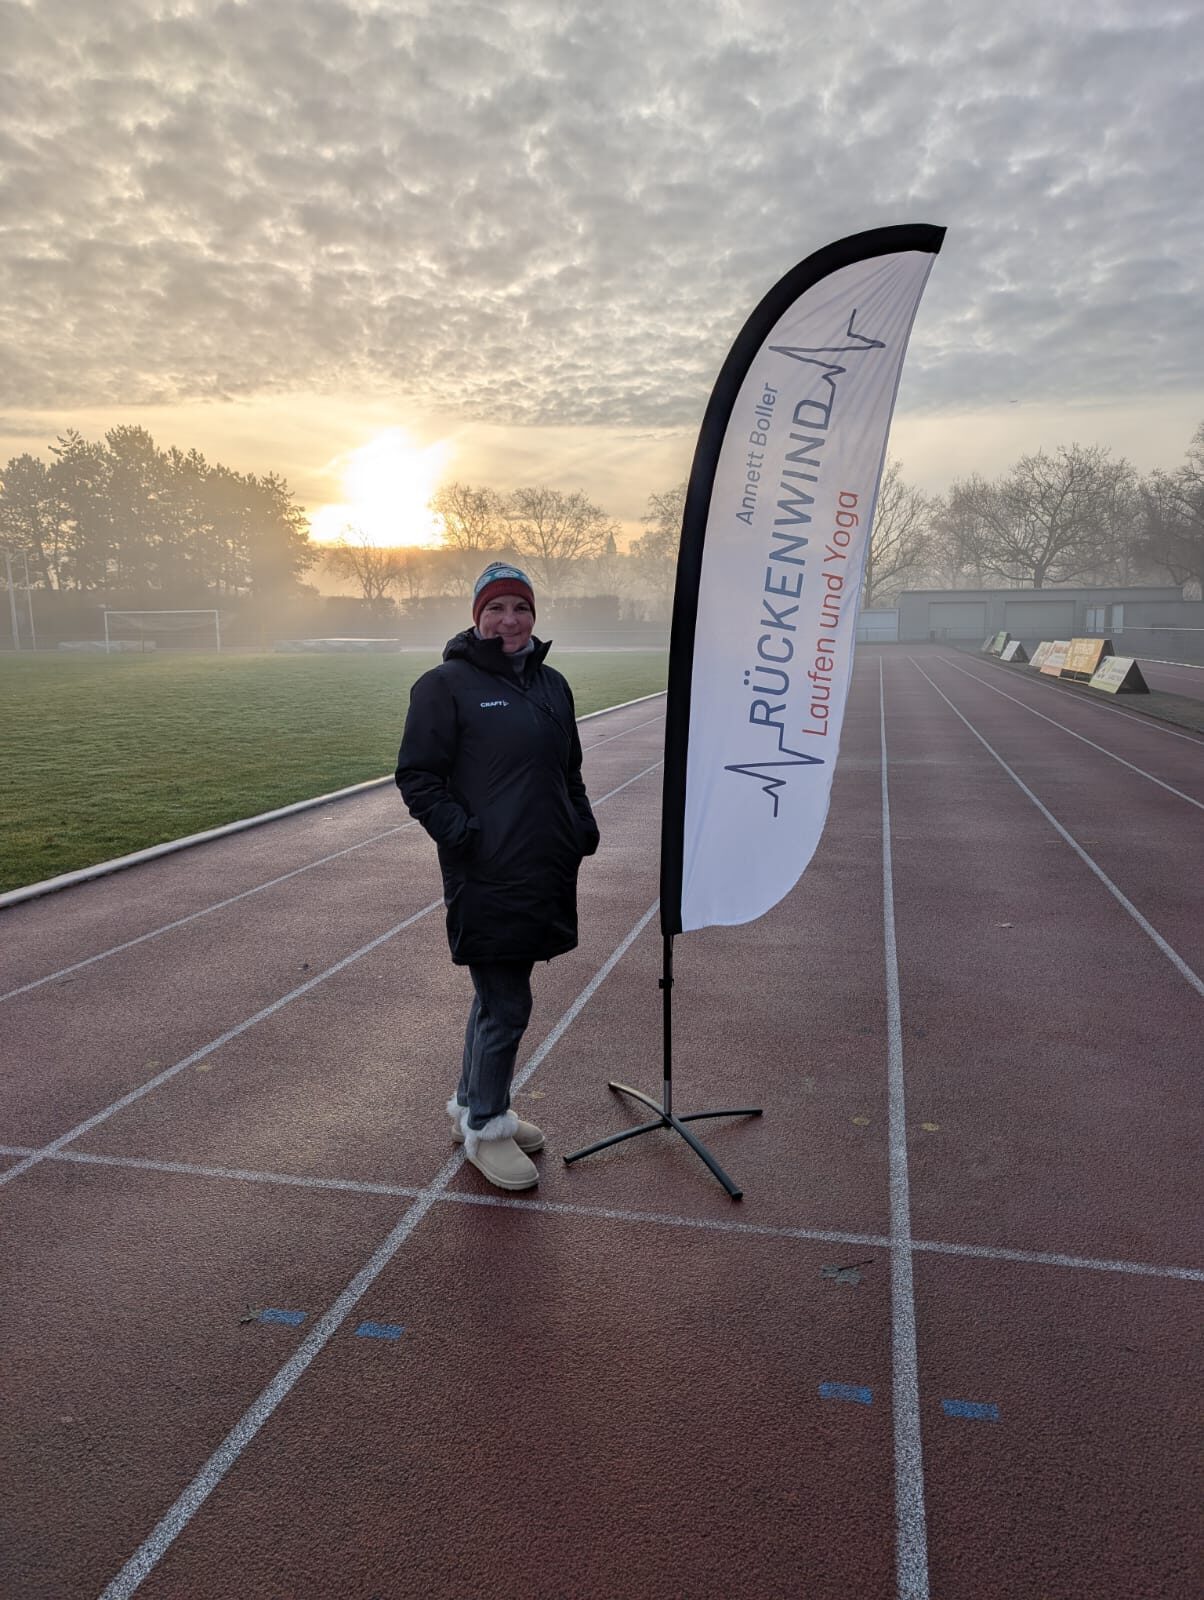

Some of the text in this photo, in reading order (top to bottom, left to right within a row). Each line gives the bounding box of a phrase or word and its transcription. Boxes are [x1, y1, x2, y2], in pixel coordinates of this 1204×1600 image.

[736, 382, 779, 526] Annett Boller
[743, 399, 830, 726] RÜCKENWIND
[802, 491, 860, 737] Laufen und Yoga
